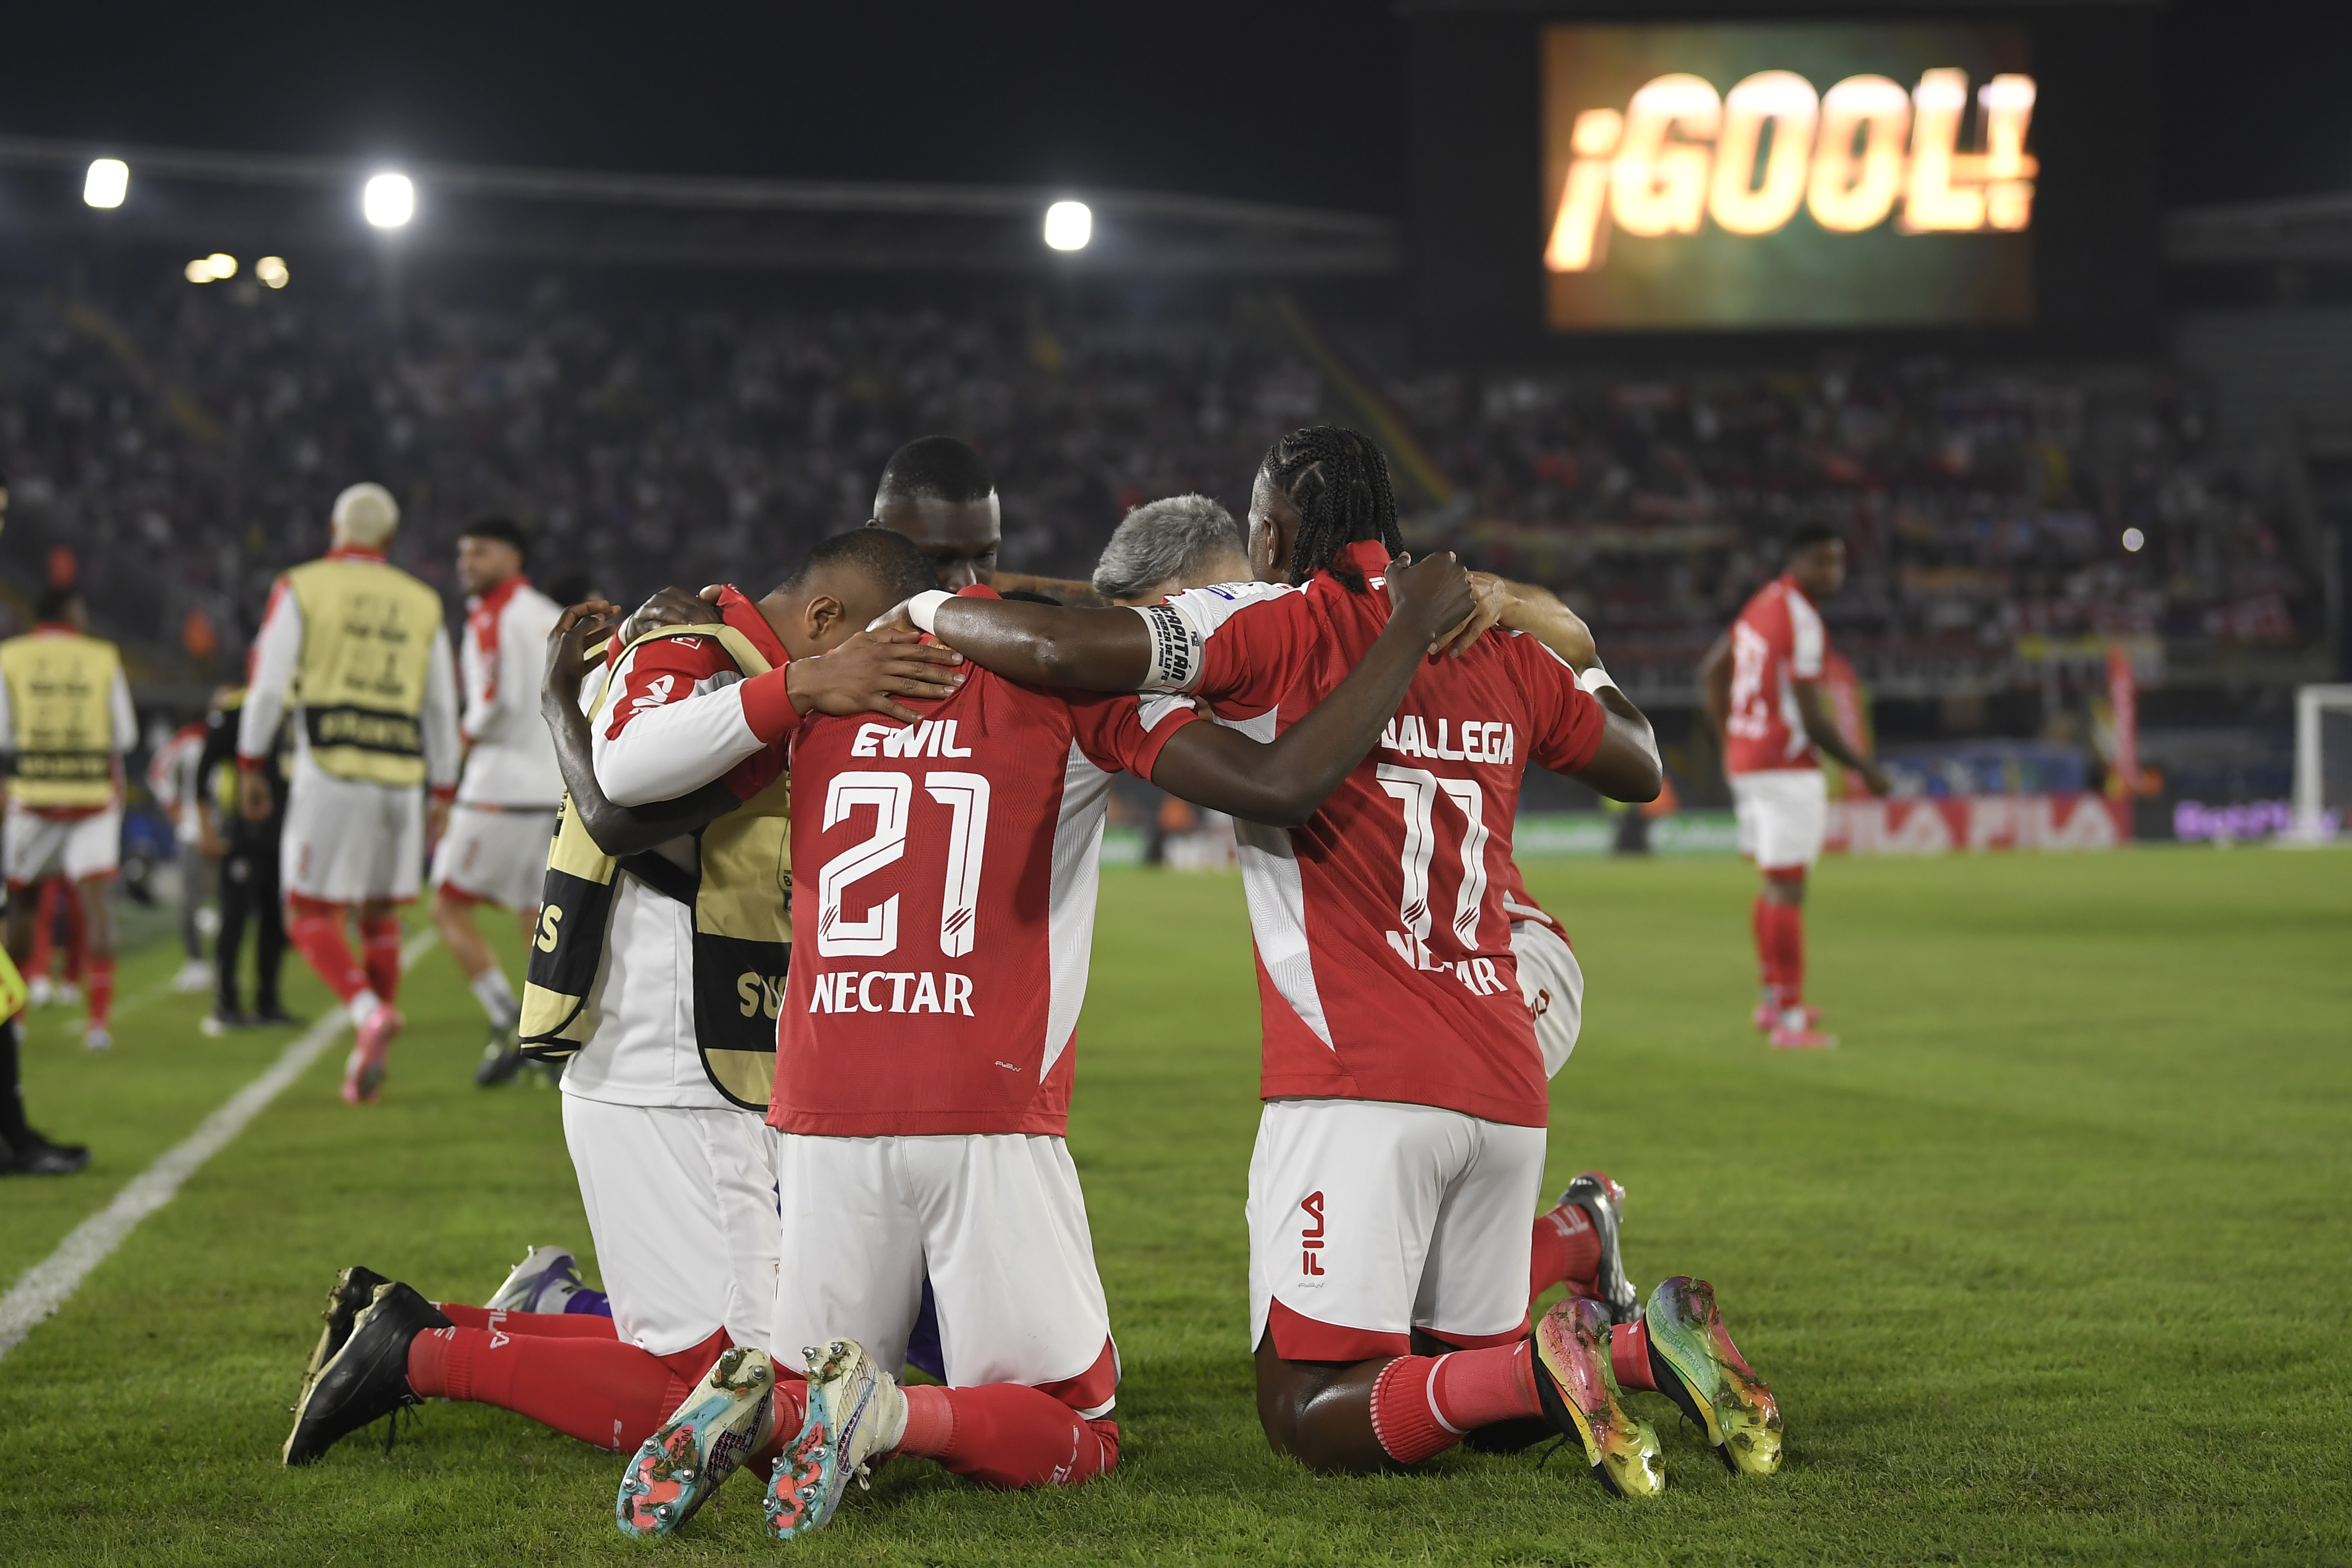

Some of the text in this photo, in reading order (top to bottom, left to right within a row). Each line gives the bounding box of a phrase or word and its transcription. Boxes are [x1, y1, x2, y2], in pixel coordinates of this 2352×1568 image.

[1543, 67, 2039, 273] ¡GOOL!
[1154, 613, 1172, 642] FUERZA
[1165, 643, 1173, 656] DE
[1161, 670, 1170, 681] FE
[1164, 657, 1173, 670] LA
[851, 719, 972, 758] EWIL
[1375, 715, 1514, 765] DALLEGA
[1966, 797, 2115, 850] FILA
[817, 771, 991, 958] 21
[809, 971, 975, 1017] NECTAR
[1301, 1190, 1325, 1276] FILA
